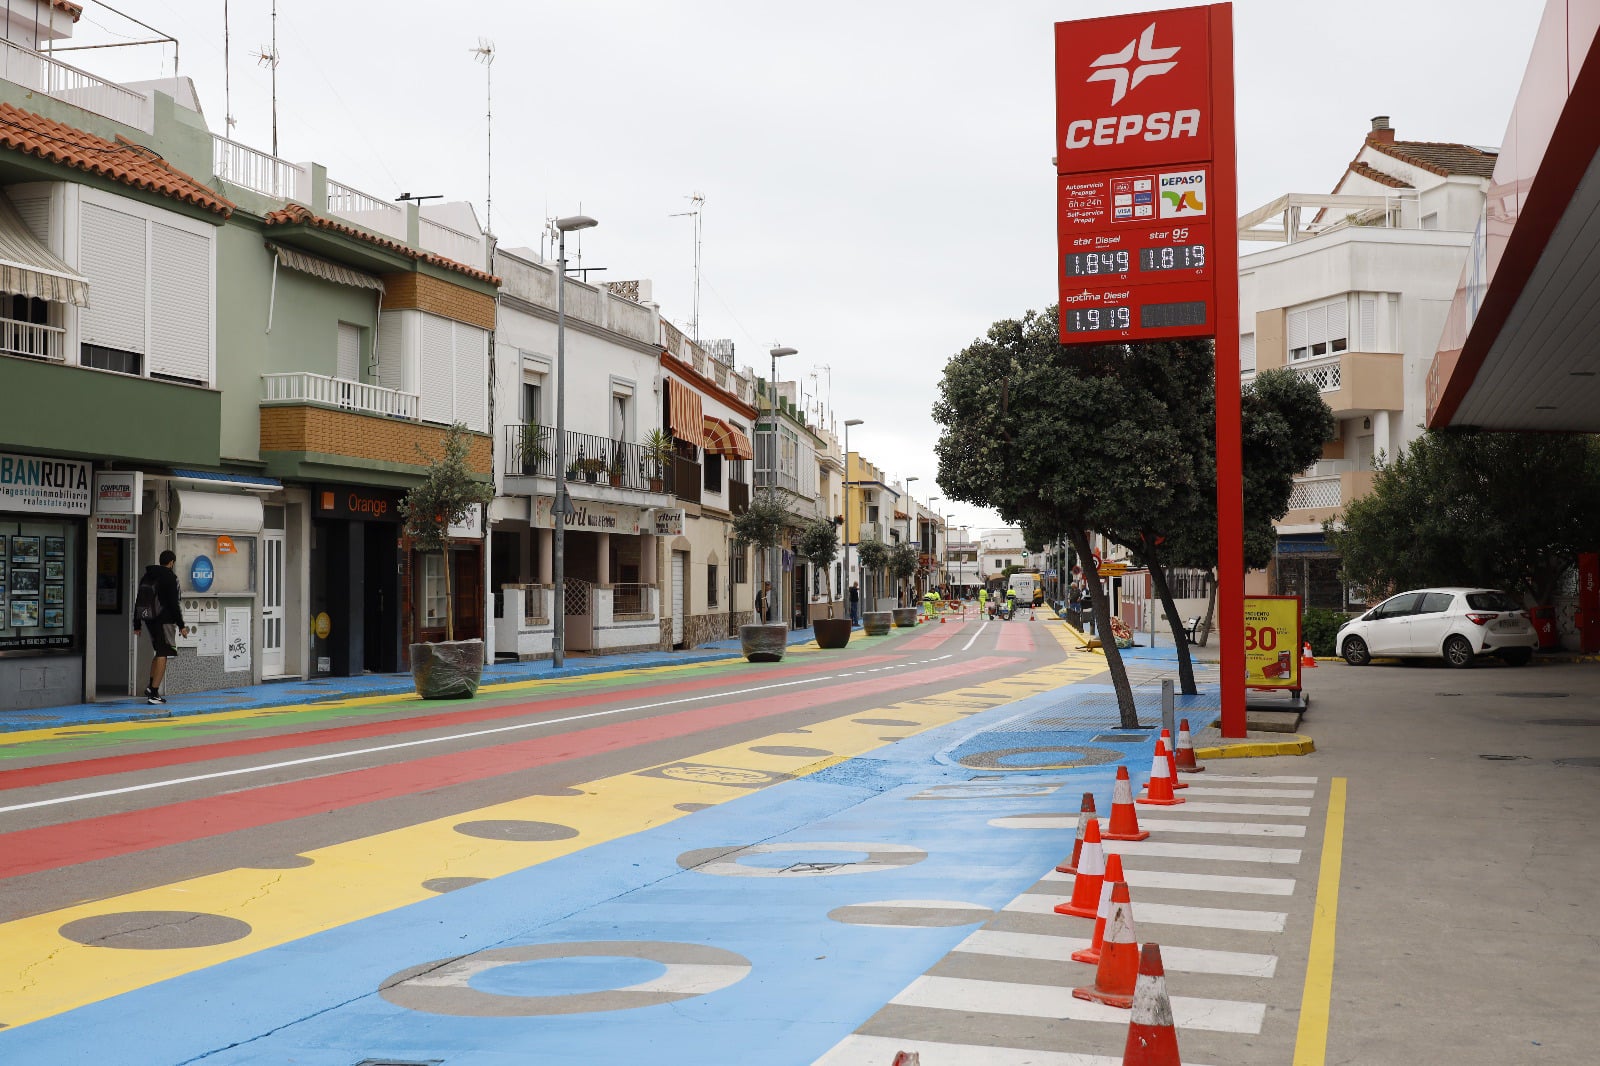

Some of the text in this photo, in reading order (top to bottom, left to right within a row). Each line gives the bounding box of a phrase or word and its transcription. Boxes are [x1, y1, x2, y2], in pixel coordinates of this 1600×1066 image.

[1066, 108, 1200, 149] CEPSA
[1161, 175, 1203, 187] DEPASO
[1086, 198, 1102, 207] 24h
[1150, 228, 1189, 240] star 95
[1073, 237, 1093, 246] star
[1095, 235, 1121, 245] Diesel
[1075, 251, 1129, 275] 1.849
[1066, 291, 1101, 303] optima
[1103, 291, 1130, 300] Diesel
[1, 456, 88, 491] BANROTA
[100, 484, 130, 492] COMPUTER
[348, 494, 387, 517] Orange
[657, 512, 681, 522] Abril
[192, 571, 213, 579] DIGI
